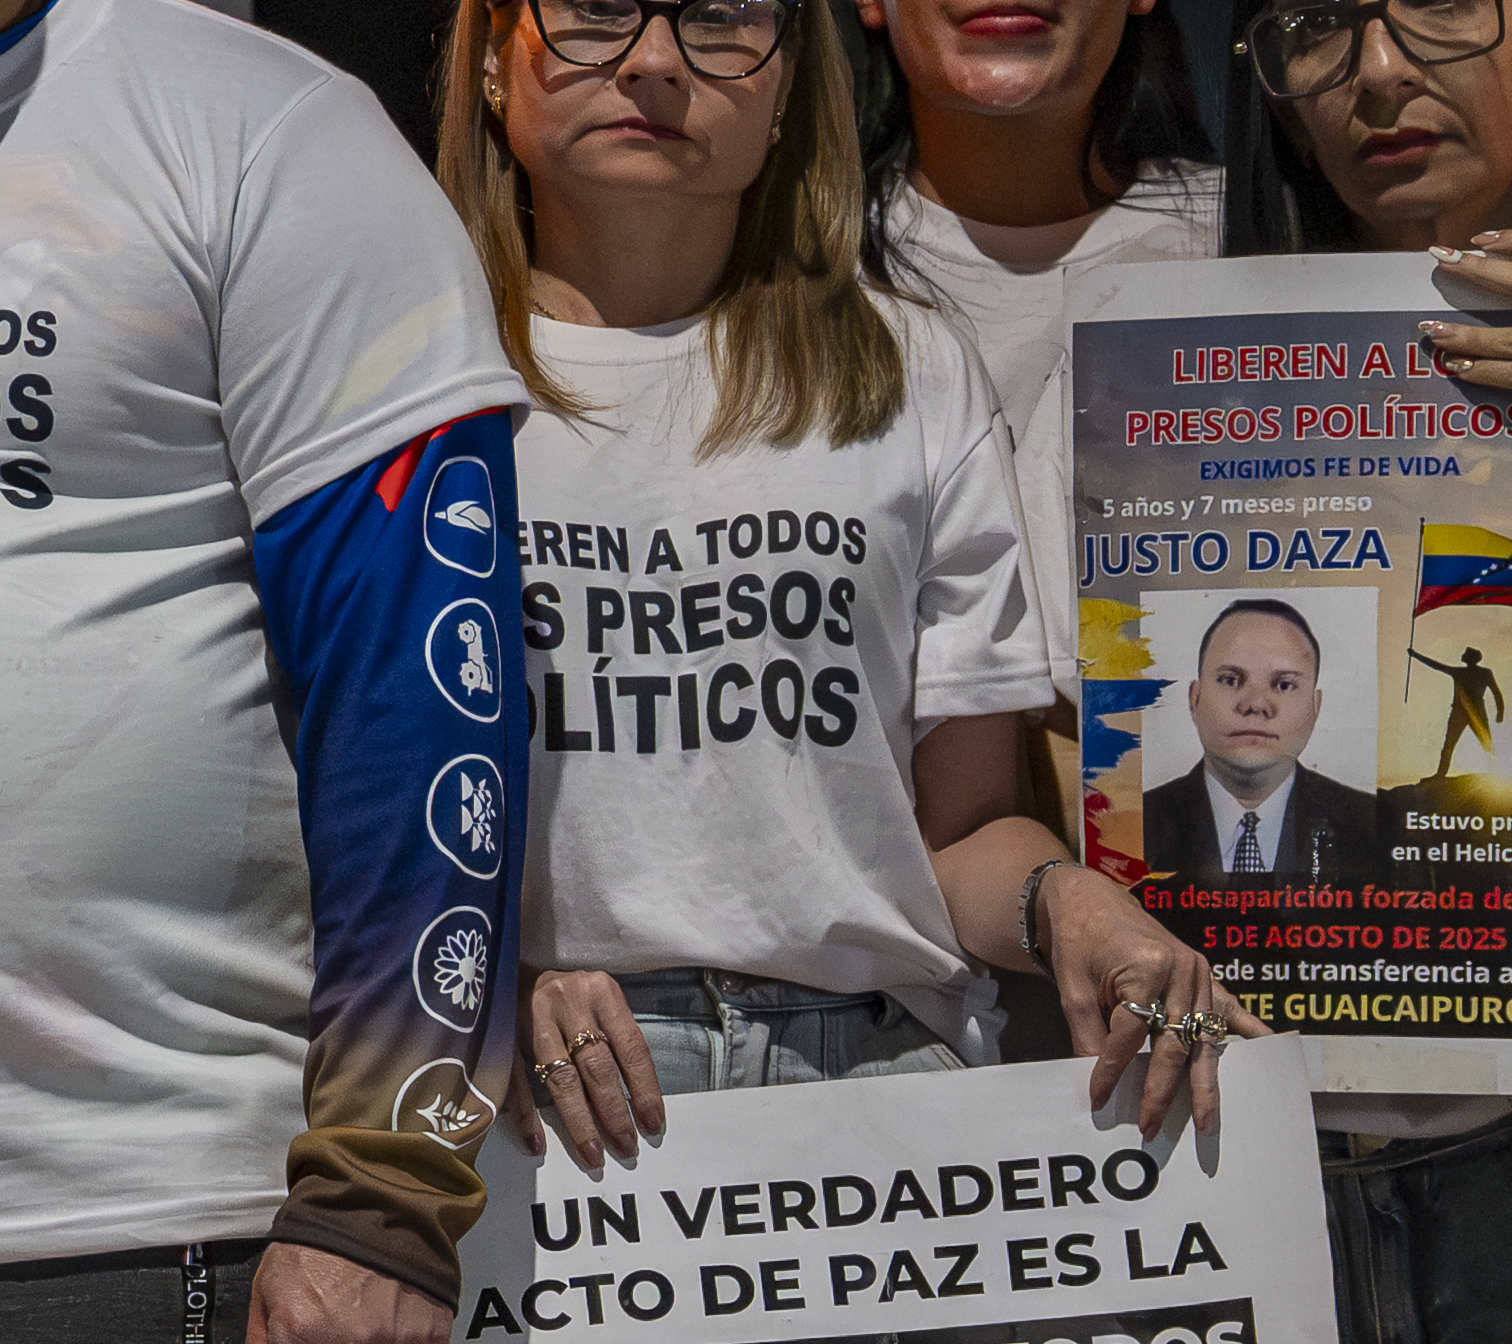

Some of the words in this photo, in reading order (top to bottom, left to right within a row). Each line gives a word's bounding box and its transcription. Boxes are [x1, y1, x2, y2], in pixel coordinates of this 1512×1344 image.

[1172, 343, 1348, 386] LIBEREN
[1359, 342, 1397, 379] A
[1125, 407, 1283, 447] PRESOS
[1293, 394, 1512, 442] POLÍTICO
[1200, 457, 1316, 481] EXIGIMOS
[1324, 457, 1351, 478] FE
[1359, 457, 1390, 478] DE
[1398, 456, 1462, 478] VIDA
[1102, 498, 1115, 518] 5
[1120, 493, 1175, 518] años
[1180, 499, 1195, 521] y
[1201, 495, 1214, 515] 7
[1221, 496, 1296, 515] meses
[1302, 495, 1373, 518] preso
[517, 520, 630, 574] EREN
[644, 528, 684, 574] A
[695, 509, 867, 565] TODOS
[1080, 529, 1231, 588] JUSTO
[1247, 528, 1393, 573] DAZA
[586, 570, 856, 656] PRESOS
[536, 656, 861, 754] LÍTICOS
[1406, 811, 1485, 831] Estuvo
[1392, 846, 1422, 862] en
[1427, 842, 1449, 862] el
[1455, 843, 1512, 863] Helic
[1144, 887, 1173, 909] En
[1180, 884, 1354, 915] desaparición
[1363, 884, 1475, 910] forzada
[1204, 926, 1217, 949] 5
[1226, 926, 1259, 948] DE
[1265, 925, 1383, 950] AGOSTO
[1392, 926, 1431, 950] DE
[1439, 927, 1507, 951] 2025
[1213, 958, 1255, 981] sde
[1261, 963, 1290, 981] su
[1298, 959, 1489, 983] transferencia
[1285, 994, 1512, 1024] GUAICAIPUR
[530, 1192, 642, 1252] UN
[659, 1147, 1161, 1239] VERDADERO
[465, 1268, 677, 1340] ACTO
[701, 1258, 807, 1317] DE
[828, 1243, 985, 1307] PAZ
[1009, 1232, 1101, 1294] ES
[1126, 1221, 1228, 1281] LA
